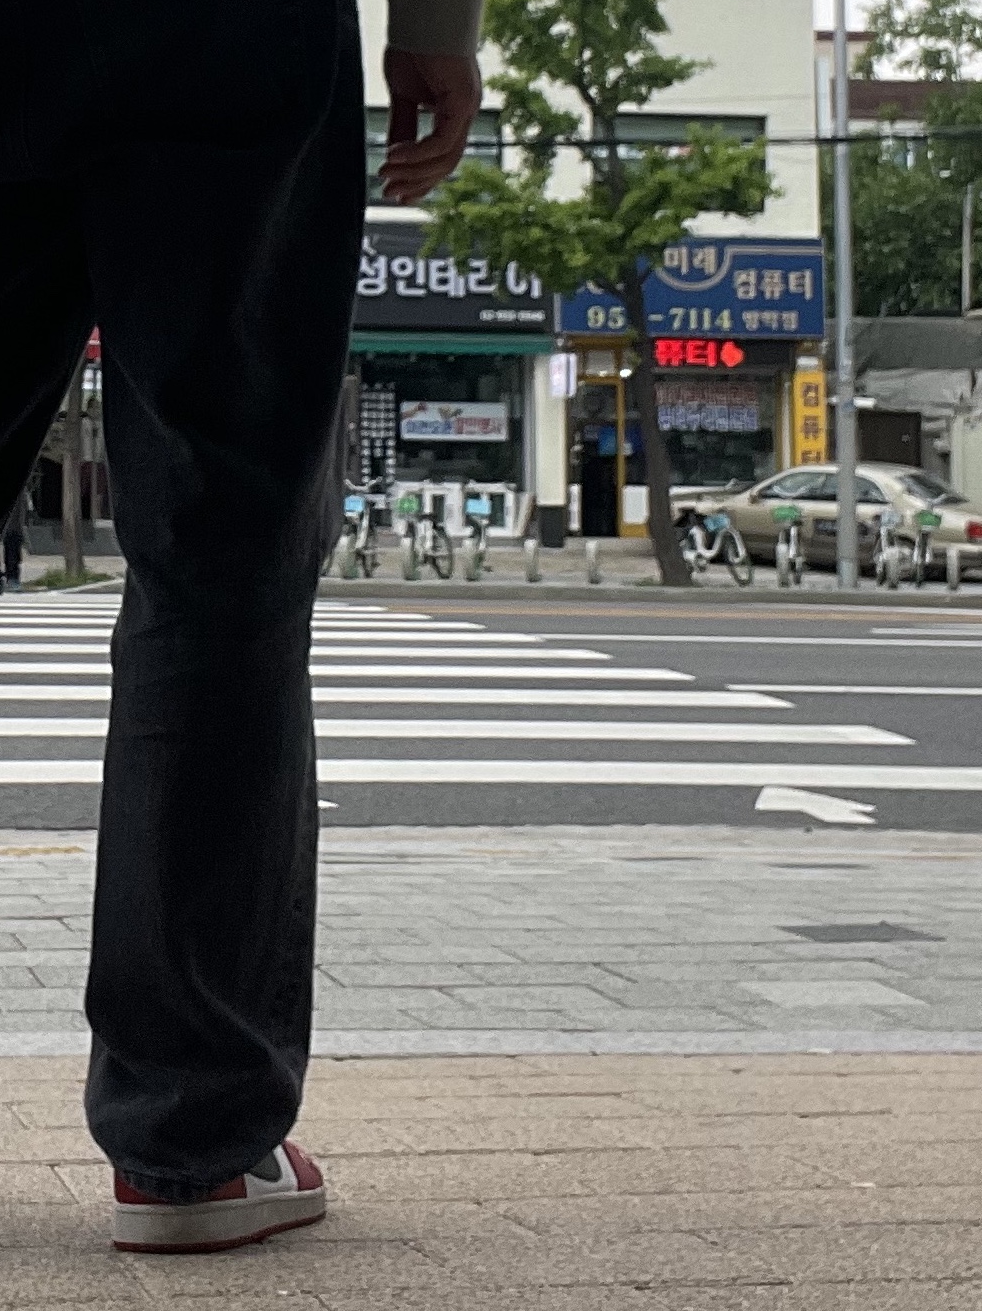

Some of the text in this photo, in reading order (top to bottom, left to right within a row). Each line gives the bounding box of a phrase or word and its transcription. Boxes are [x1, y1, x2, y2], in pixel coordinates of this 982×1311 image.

[664, 246, 717, 276] 미래
[734, 269, 814, 300] 컴퓨터
[586, 306, 733, 331] 95-7114
